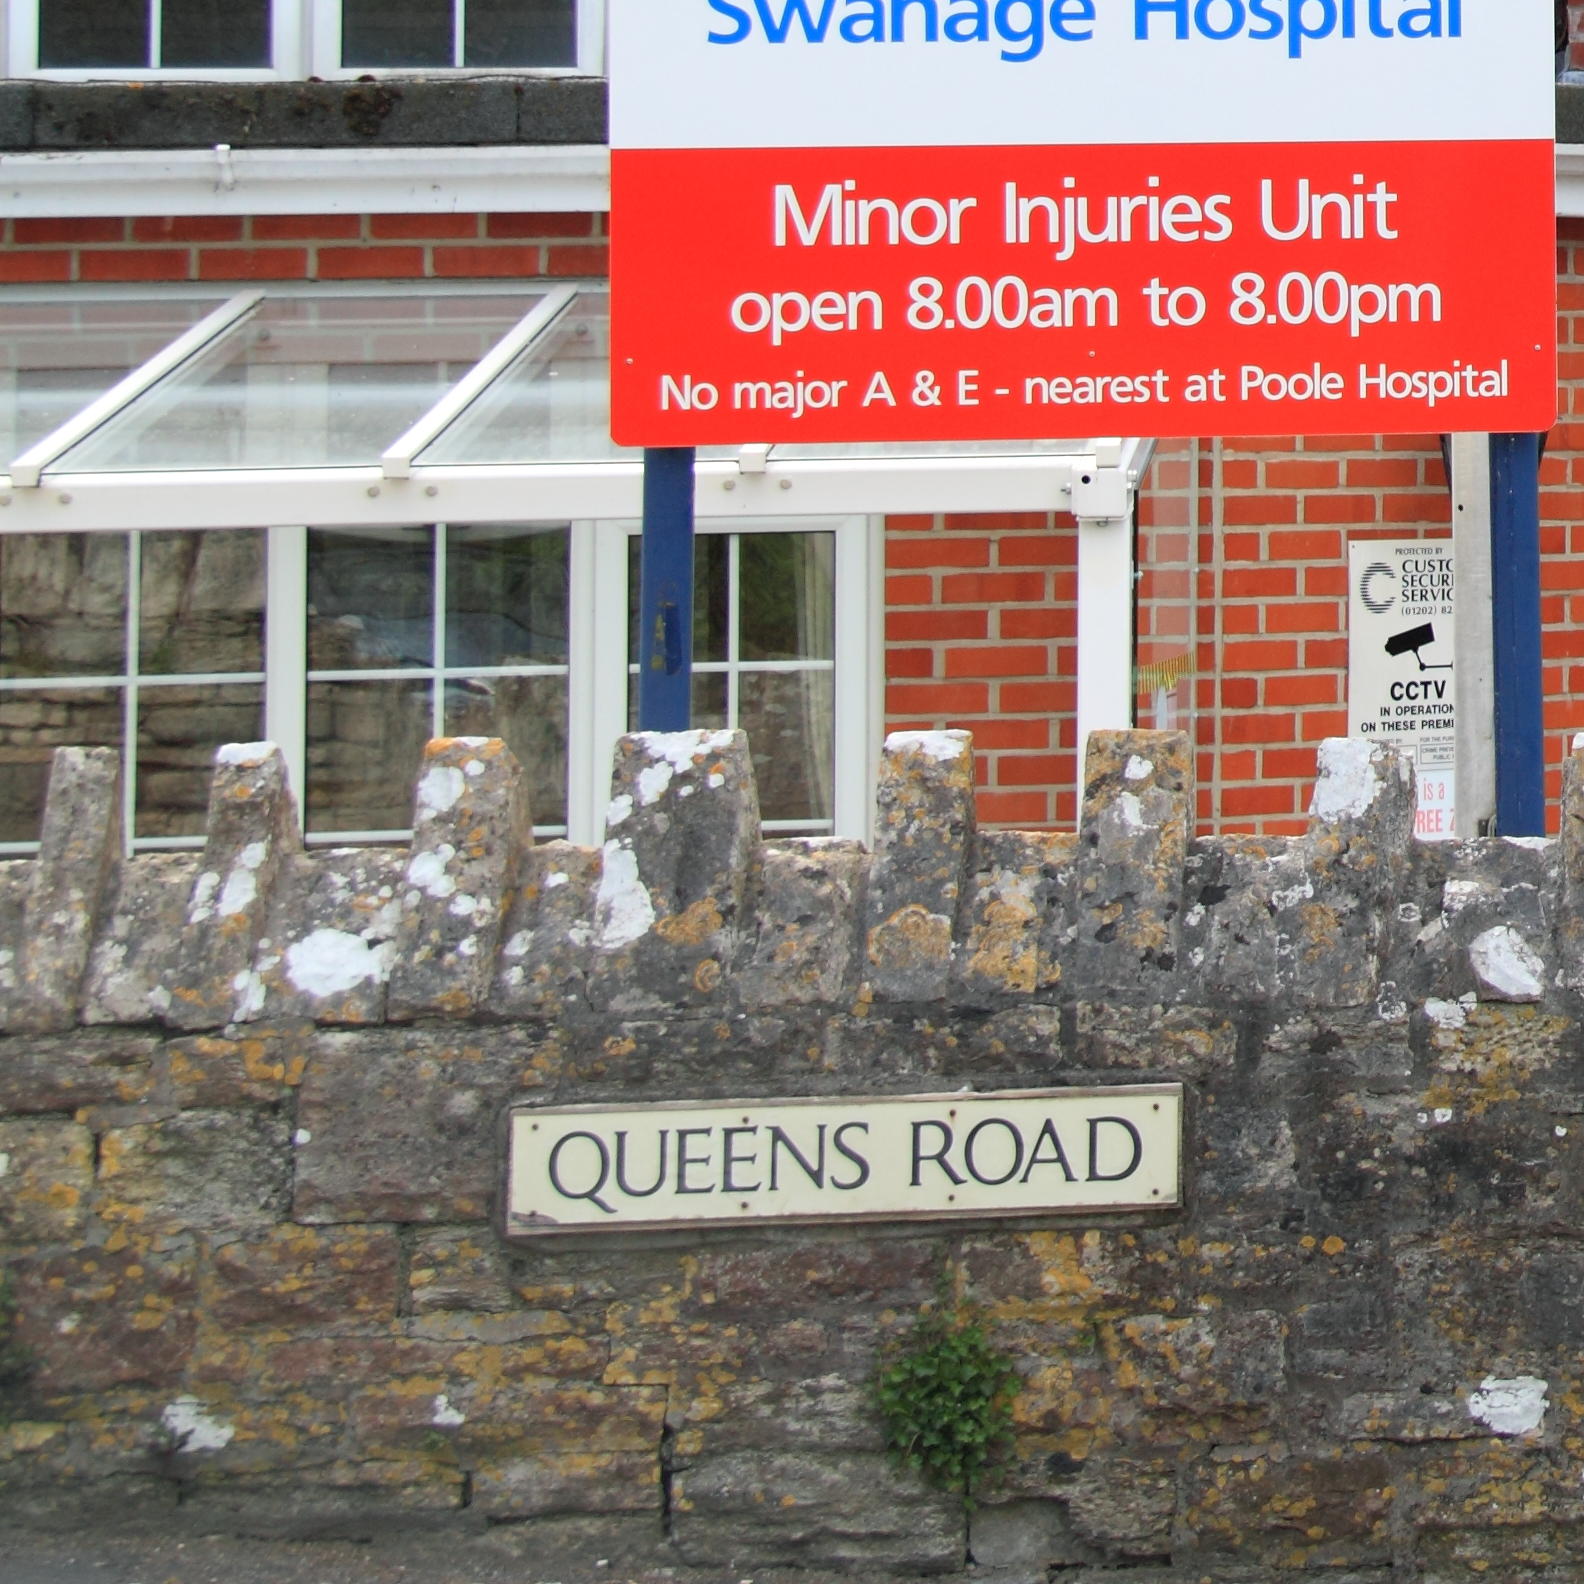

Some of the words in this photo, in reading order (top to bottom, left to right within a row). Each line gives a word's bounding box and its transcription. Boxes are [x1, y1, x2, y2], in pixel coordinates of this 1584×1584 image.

[773, 180, 977, 247] Minor
[1004, 177, 1232, 261] Injuries
[1260, 174, 1399, 242] Unit
[730, 290, 883, 346] open
[907, 277, 1119, 331] 8.00am
[1143, 280, 1205, 327] to
[1229, 273, 1442, 337] 8.00pm
[661, 374, 719, 411] No
[734, 371, 847, 418] major
[863, 374, 896, 407] A
[911, 373, 942, 407] &
[958, 372, 979, 406] E
[1025, 368, 1169, 404] nearest
[1185, 369, 1226, 401] at
[1241, 365, 1345, 400] Poole
[1359, 361, 1509, 407] Hospital
[1395, 547, 1433, 555] PROTECTED
[1402, 559, 1453, 573] CUSTO
[1402, 574, 1453, 588] SECURI
[1390, 680, 1446, 701] CCTV
[1380, 706, 1391, 717] IN
[1361, 722, 1376, 733] ON
[1382, 720, 1416, 731] THESE
[1421, 718, 1454, 729] PREMI
[1417, 809, 1443, 833] REE
[548, 1121, 871, 1214] QUEENS
[909, 1117, 1142, 1187] ROAD
